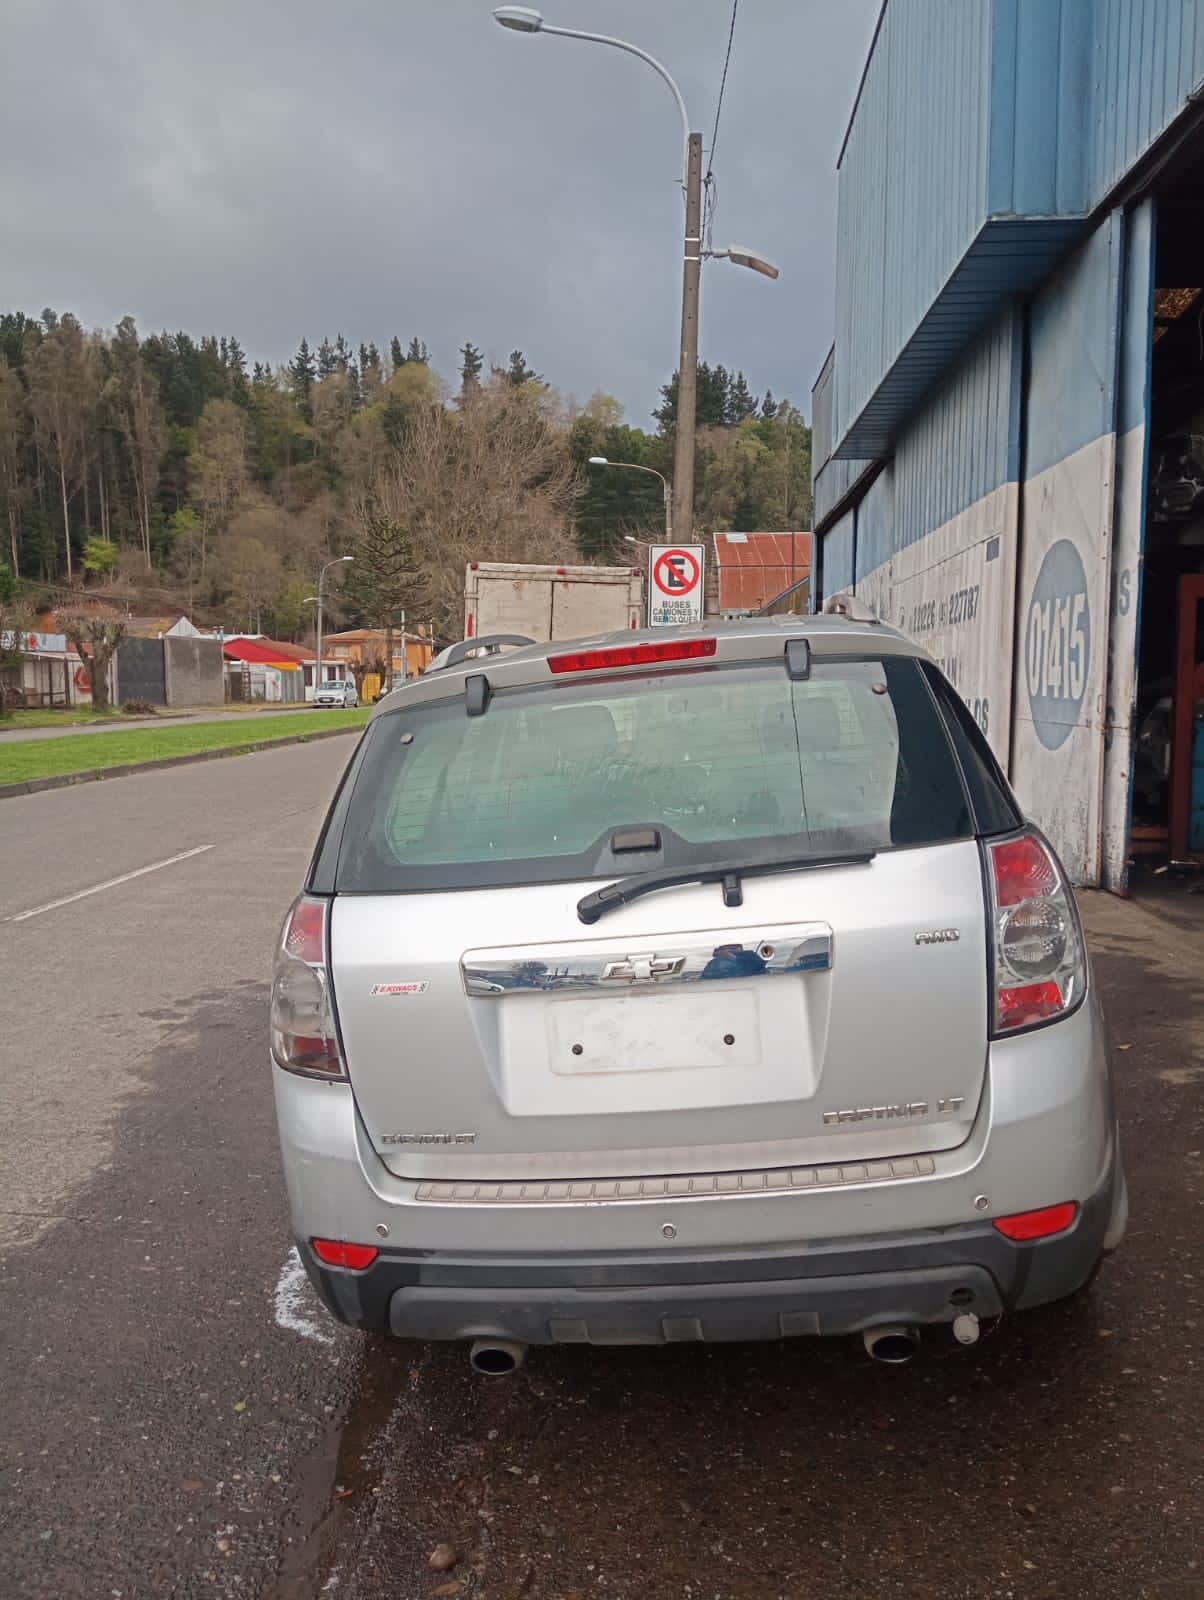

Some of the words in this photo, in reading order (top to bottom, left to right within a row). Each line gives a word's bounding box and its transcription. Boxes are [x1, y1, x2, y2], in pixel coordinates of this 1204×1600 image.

[662, 600, 690, 609] BUSES
[652, 608, 691, 616] CAMIONES
[694, 608, 699, 616] Y
[1028, 592, 1086, 701] 01415
[823, 1102, 928, 1126] CAPTIVA
[938, 1097, 964, 1112] LT
[382, 1133, 476, 1145] CHEVROLET
